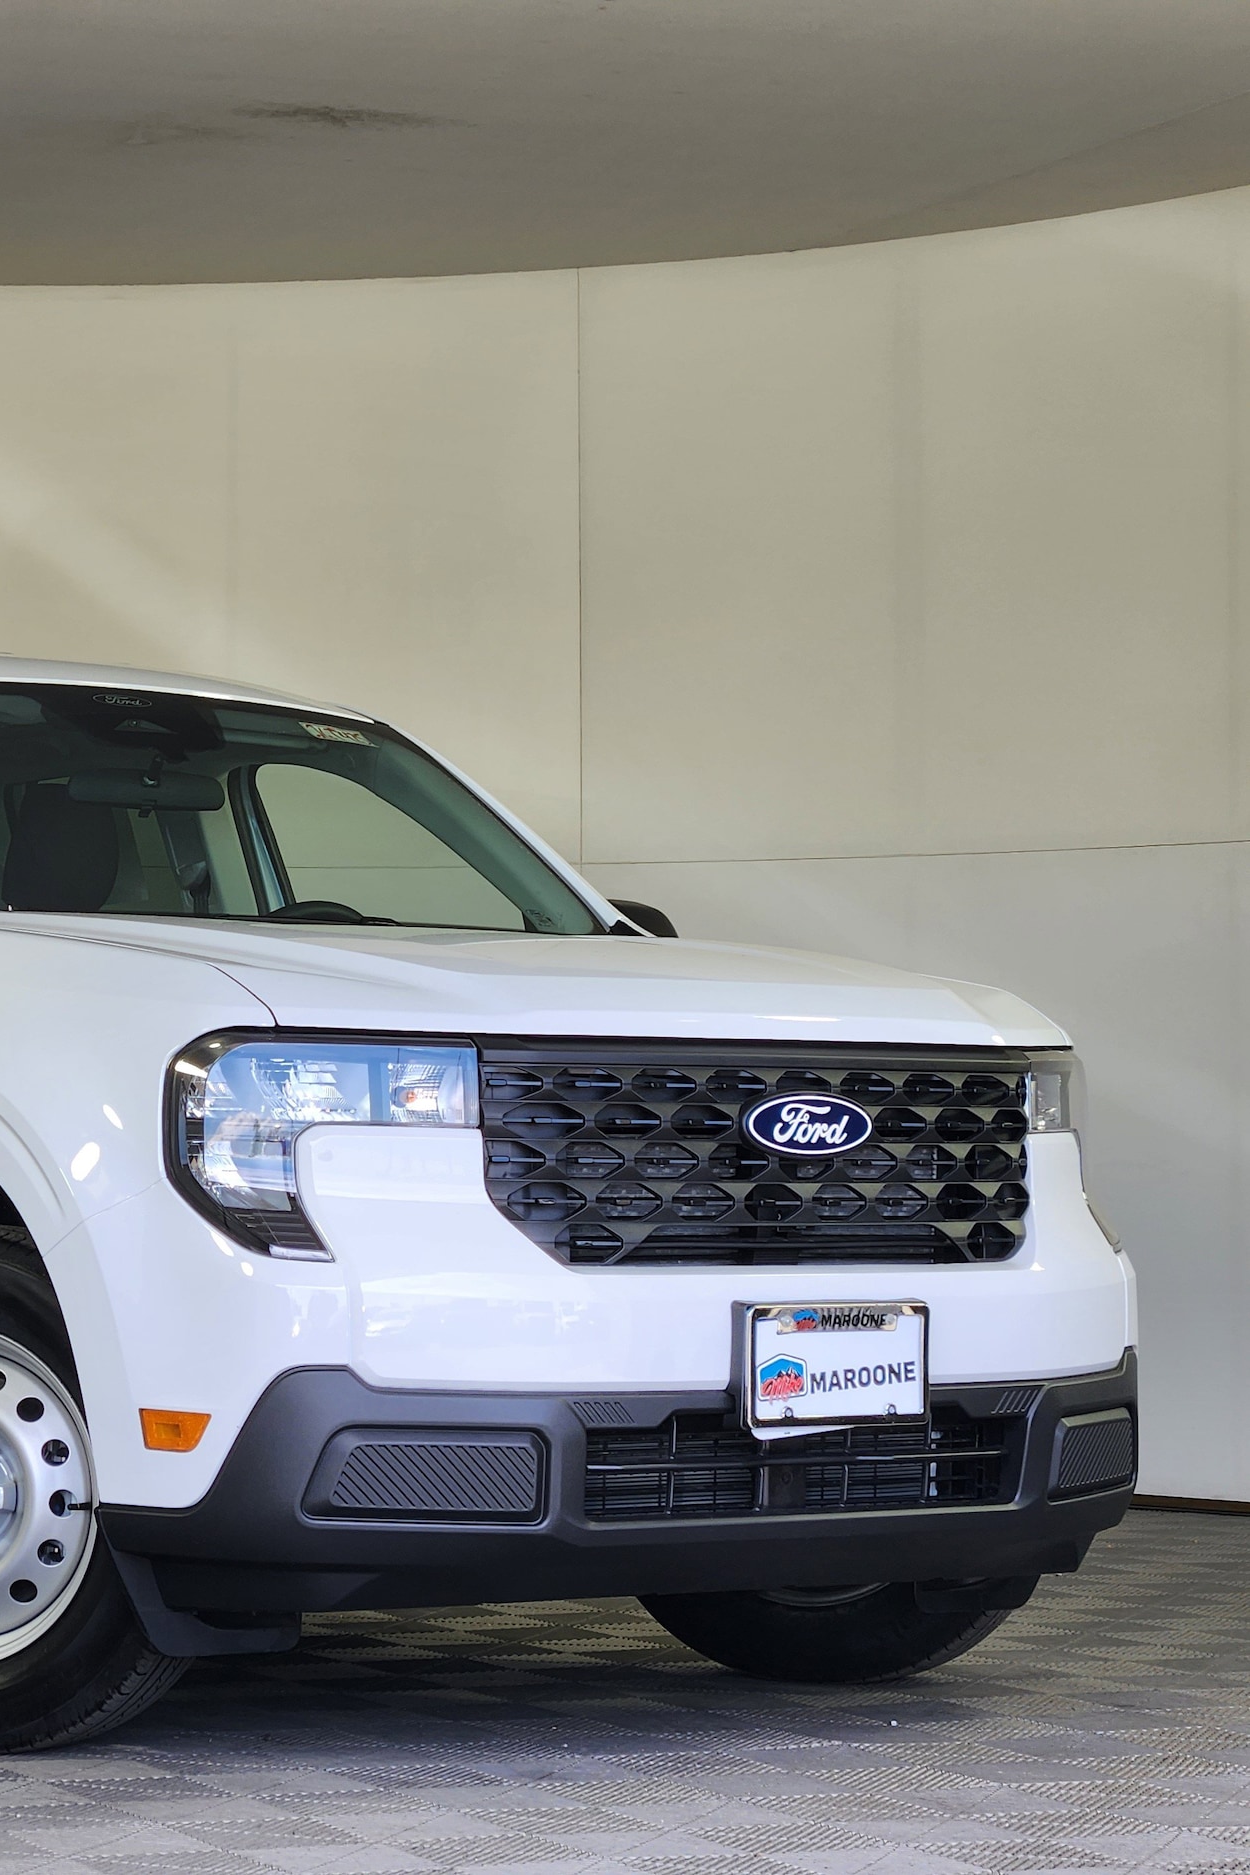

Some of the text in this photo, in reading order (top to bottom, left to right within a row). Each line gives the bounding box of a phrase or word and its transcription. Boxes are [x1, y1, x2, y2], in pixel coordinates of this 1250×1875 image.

[105, 694, 143, 706] Ford
[773, 1103, 850, 1144] Ford
[821, 1312, 887, 1328] MAROONE
[810, 1361, 917, 1394] MAROONE
